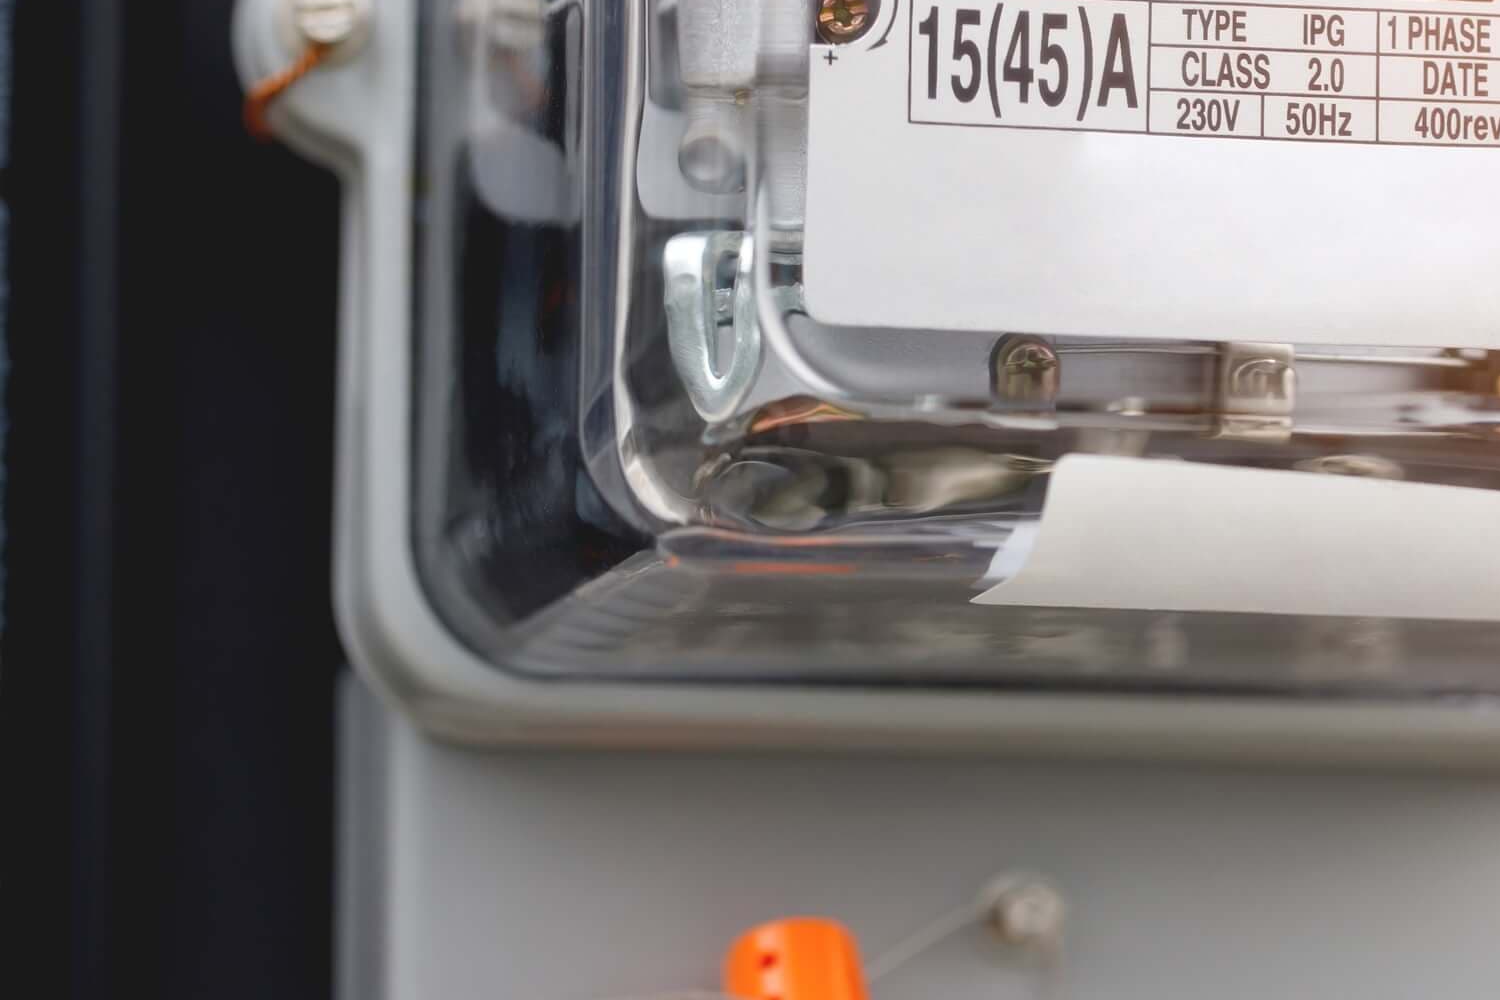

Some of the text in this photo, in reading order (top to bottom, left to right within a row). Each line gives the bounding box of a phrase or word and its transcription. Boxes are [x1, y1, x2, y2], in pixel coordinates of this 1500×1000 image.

[1182, 8, 1345, 47] TYPE IPG
[1388, 16, 1397, 49] 1
[1408, 16, 1491, 53] PHASE
[919, 2, 1138, 122] 15(45)A
[1181, 51, 1345, 93] CLASS 2.0
[1423, 61, 1489, 97] DATE
[1176, 98, 1240, 132] 230V
[1285, 103, 1353, 137] 50Hz
